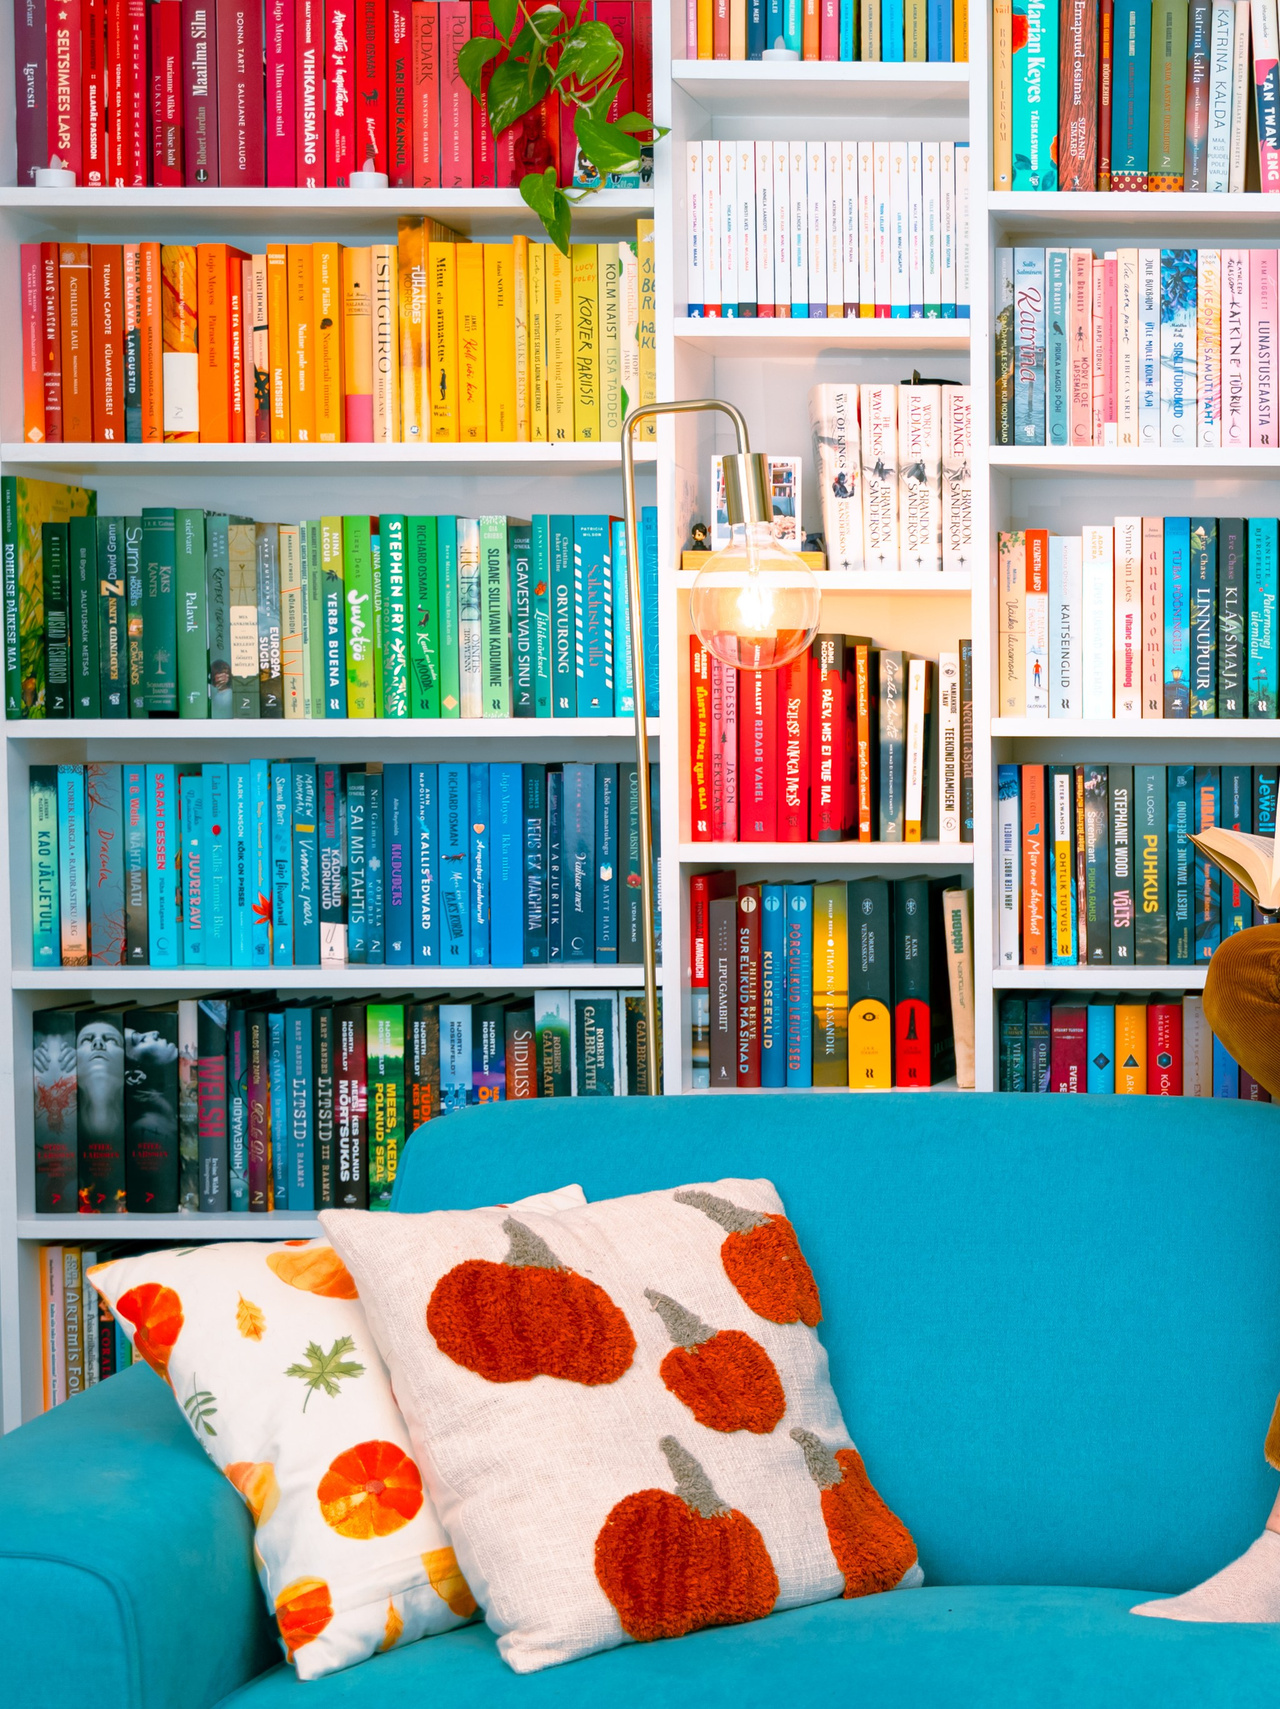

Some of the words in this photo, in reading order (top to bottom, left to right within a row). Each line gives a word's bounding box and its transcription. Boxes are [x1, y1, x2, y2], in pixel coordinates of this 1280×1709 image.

[237, 12, 245, 45] DONNA
[1070, 1, 1086, 58] Emapuud
[57, 30, 70, 111] SELTSIMEES
[167, 56, 175, 92] Marianne
[237, 49, 245, 73] TARTT
[1070, 61, 1086, 106] otsimas
[24, 63, 38, 108] Igavesti
[167, 95, 175, 119] Mikko
[237, 84, 246, 127] SALAJANE
[303, 50, 317, 164] VIHKAMISMÄNG
[1262, 73, 1279, 102] TAN
[57, 115, 70, 149] LAPS
[1070, 121, 1078, 157] SIMARD
[1077, 118, 1085, 161] SUZANNE
[1262, 107, 1279, 146] TWAN
[237, 130, 246, 170] AJALUGU
[1262, 153, 1279, 181] ENG
[103, 264, 112, 299] TRUMAN
[126, 253, 135, 268] KUS
[605, 263, 616, 300] KOLM
[103, 302, 112, 334] CAPOTE
[126, 271, 135, 331] LAULAVAD
[376, 253, 391, 373] ISHIGURO
[605, 303, 616, 340] NAIST
[1016, 287, 1042, 384] Katrina
[104, 344, 114, 415] KÜLMAVERELISELT
[126, 335, 135, 394] LANGUSTID
[1258, 321, 1271, 426] LUNASTUSEAASTA
[274, 369, 285, 418] NARTSISSIST
[906, 483, 919, 551] SANDERSON
[917, 489, 929, 545] BRANDON
[4, 544, 17, 597] ROHELISE
[388, 522, 403, 597] STEPHEN
[487, 548, 501, 585] SLOANE
[516, 558, 530, 616] IGAVESTI
[4, 600, 17, 642] PÄIKESE
[184, 591, 197, 632] Palavik
[327, 592, 339, 635] YERBA
[388, 603, 403, 634] FRY
[487, 587, 501, 635] SULLIVANI
[556, 585, 569, 673] ORVURONG
[516, 619, 530, 651] VAID
[1059, 604, 1072, 688] KAITSEINGLID
[1196, 588, 1210, 690] LINNUPUUR
[1224, 586, 1239, 690] KLAASMAJA
[4, 646, 17, 671] MAA
[327, 640, 339, 686] BUENA
[487, 637, 501, 687] KADUMINE
[516, 655, 530, 686] SINU
[944, 728, 956, 762] TEEKOND
[155, 773, 166, 812] SARAH
[944, 764, 956, 812] RIDAMUSENI
[350, 805, 364, 832] SAI
[1087, 811, 1096, 863] Sarenbrant
[1114, 789, 1129, 844] STEPHANIE
[38, 831, 55, 856] KAO
[97, 828, 115, 888] Dracula
[155, 815, 166, 870] DESSEN
[350, 836, 364, 863] MIS
[420, 833, 431, 874] KALLIS
[1114, 848, 1129, 877] WOOD
[1058, 853, 1068, 888] OHTLIK
[1143, 835, 1158, 913] PUHKUS
[38, 860, 55, 934] JÄLJETULT
[350, 868, 364, 924] TAHTIS
[420, 880, 431, 929] EDWARD
[602, 884, 610, 910] MATT
[1058, 894, 1068, 932] TUTVUS
[1113, 890, 1130, 927] VÕLTS
[602, 917, 610, 941] HAIG
[739, 928, 749, 1004] SURELIKUD
[718, 958, 728, 1032] LIPUGAMBIIT
[763, 951, 773, 1049] KULDSEEKLID
[583, 1006, 597, 1090] GALBRAITH
[596, 1028, 604, 1068] ROBERT
[739, 1007, 749, 1073] MASINAD
[199, 1056, 225, 1137] WELSH
[374, 1083, 385, 1141] POLNUD
[385, 1083, 397, 1133] MEES,
[374, 1146, 385, 1181] SEAL
[385, 1139, 397, 1182] KEDA
